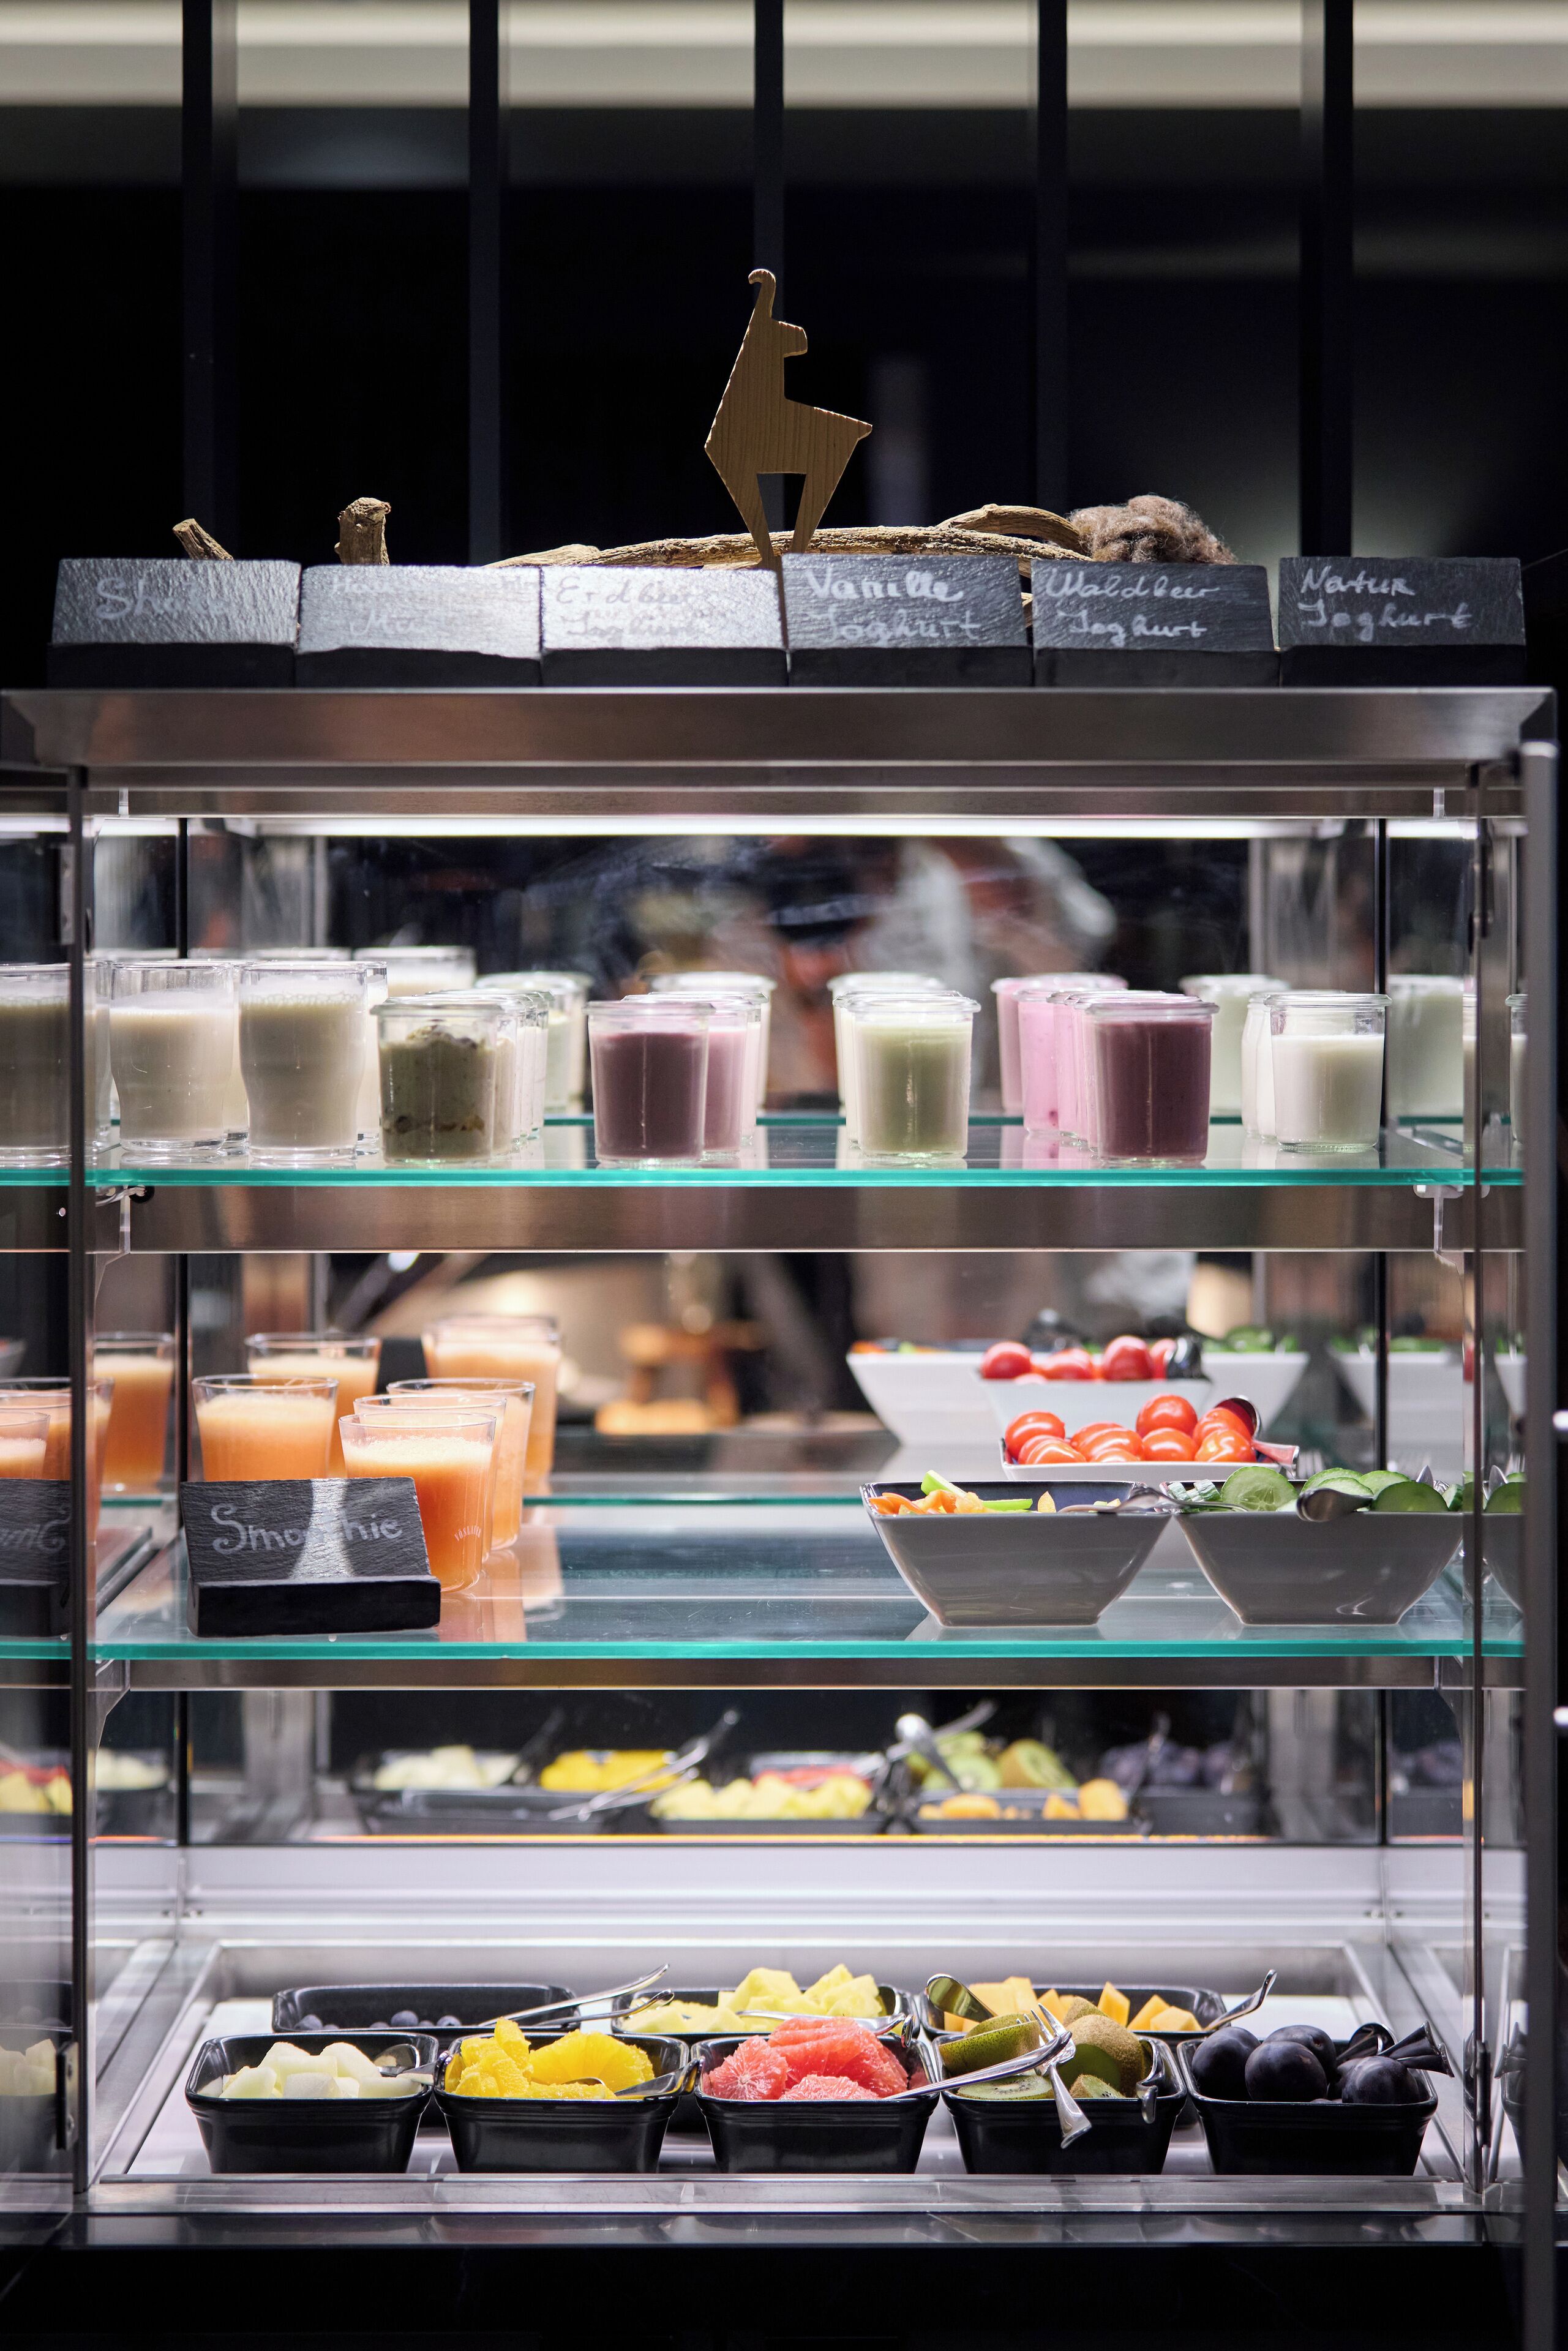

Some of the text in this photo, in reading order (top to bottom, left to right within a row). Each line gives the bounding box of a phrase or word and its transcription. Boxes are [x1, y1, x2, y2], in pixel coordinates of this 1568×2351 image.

[806, 568, 964, 602] Vanille
[1044, 567, 1220, 599] Waldbeer
[808, 603, 982, 646] Joghurt
[1057, 608, 1208, 648] Joghurt
[1296, 599, 1474, 642] Joghurt
[211, 1502, 403, 1555] Smoothie
